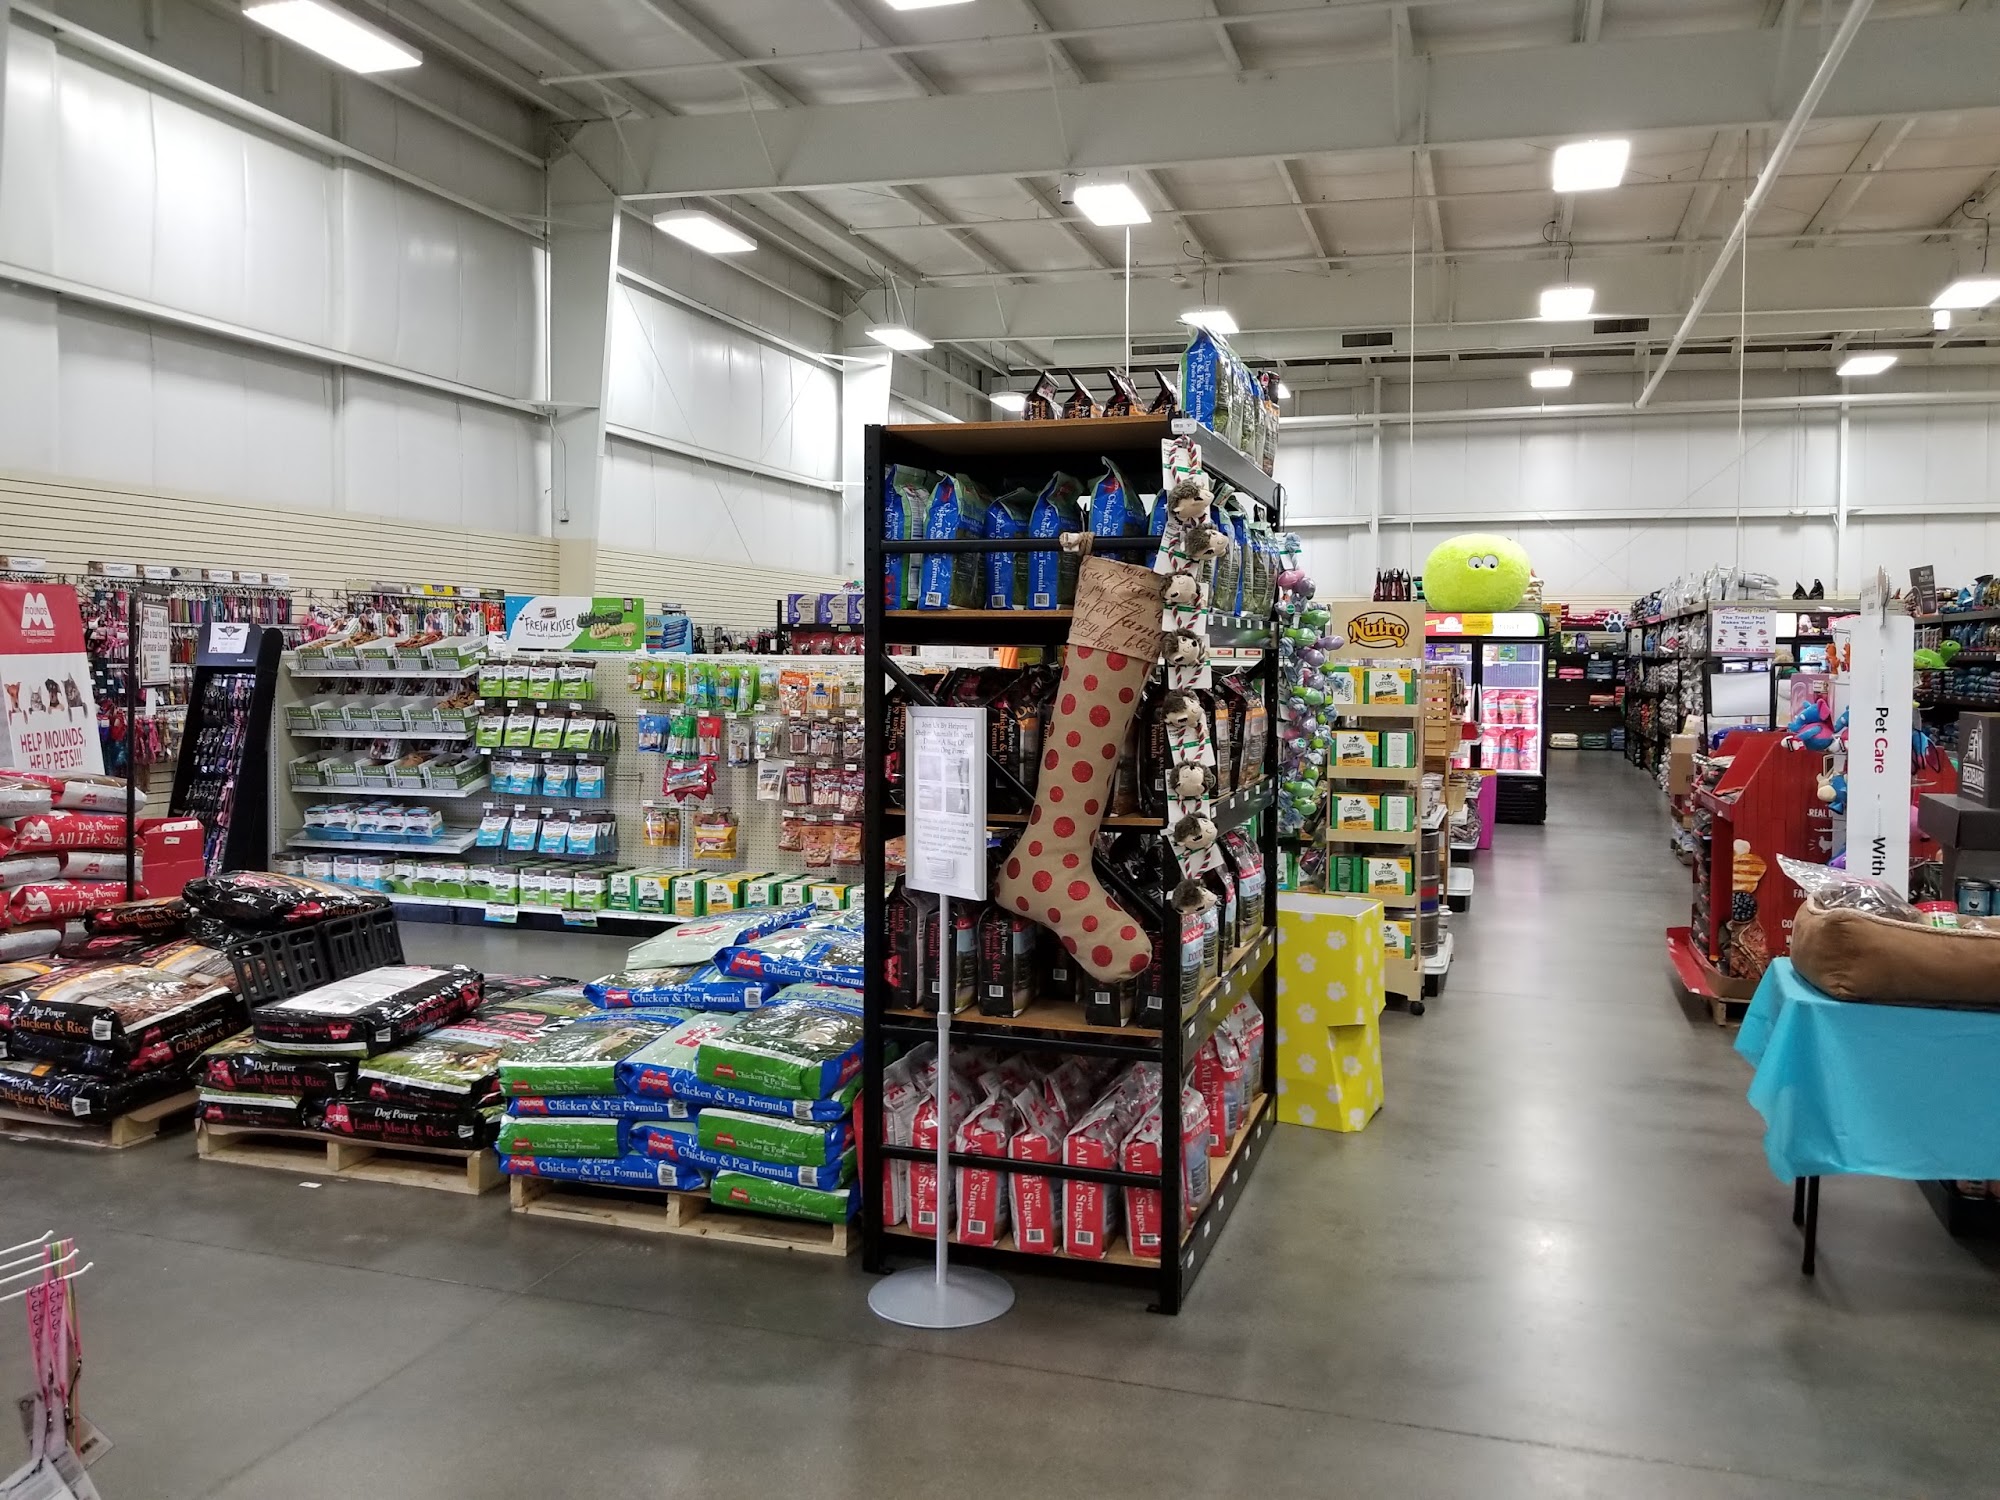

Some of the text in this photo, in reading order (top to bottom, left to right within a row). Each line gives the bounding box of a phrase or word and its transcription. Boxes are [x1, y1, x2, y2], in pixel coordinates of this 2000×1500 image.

[1038, 559, 1046, 592] Formula
[524, 617, 576, 632] FRESH KISSES
[1348, 617, 1406, 648] Nutro
[20, 727, 86, 753] HELP MOUNDS,
[992, 722, 1000, 758] Formula
[1151, 724, 1159, 760] Formula
[1874, 707, 1889, 774] Pet Care
[30, 750, 84, 769] HELP PETS!!!
[1000, 746, 1008, 756] &
[1808, 808, 1826, 818] REAL
[78, 822, 120, 832] Dog Power
[55, 832, 100, 845] All Life
[1872, 836, 1886, 876] With
[96, 890, 120, 899] Power
[54, 902, 75, 914] All
[116, 912, 153, 924] Chicken
[154, 910, 165, 920] &
[763, 962, 832, 982] Chicken & Pea
[632, 992, 740, 1004] Chicken & Pea Formula
[28, 1005, 66, 1019] Dog Power
[14, 1016, 52, 1030] Chicken
[54, 1020, 64, 1032] &
[66, 1020, 89, 1036] Rice
[175, 1034, 214, 1054] Chicken
[254, 1061, 296, 1073] Dog Power
[11, 1080, 50, 1094] Dog Power
[234, 1073, 328, 1088] Lamb Meal & Rice
[641, 1076, 669, 1088] MOUNDS
[0, 1086, 70, 1112] Chicken & Rice
[548, 1100, 664, 1113] Chicken & Pea Formula
[672, 1082, 788, 1113] Chicken & Pea Formula
[374, 1106, 418, 1121] Dog Power
[354, 1118, 450, 1138] Lamb Meal & Rice
[648, 1138, 674, 1150] MOUNDS
[920, 1132, 931, 1150] All
[971, 1139, 982, 1155] All
[678, 1146, 794, 1180] Chicken & Pea Formula
[1076, 1146, 1088, 1165] All
[1132, 1151, 1143, 1168] All
[538, 1161, 654, 1180] Chicken & Pea Formula
[980, 1176, 990, 1201] Power
[1034, 1182, 1042, 1208] Power
[968, 1184, 980, 1219] Stages
[1087, 1187, 1096, 1212] Power
[1022, 1192, 1034, 1229] Stages
[1074, 1194, 1088, 1229] Stages
[1134, 1196, 1146, 1233] Stages
